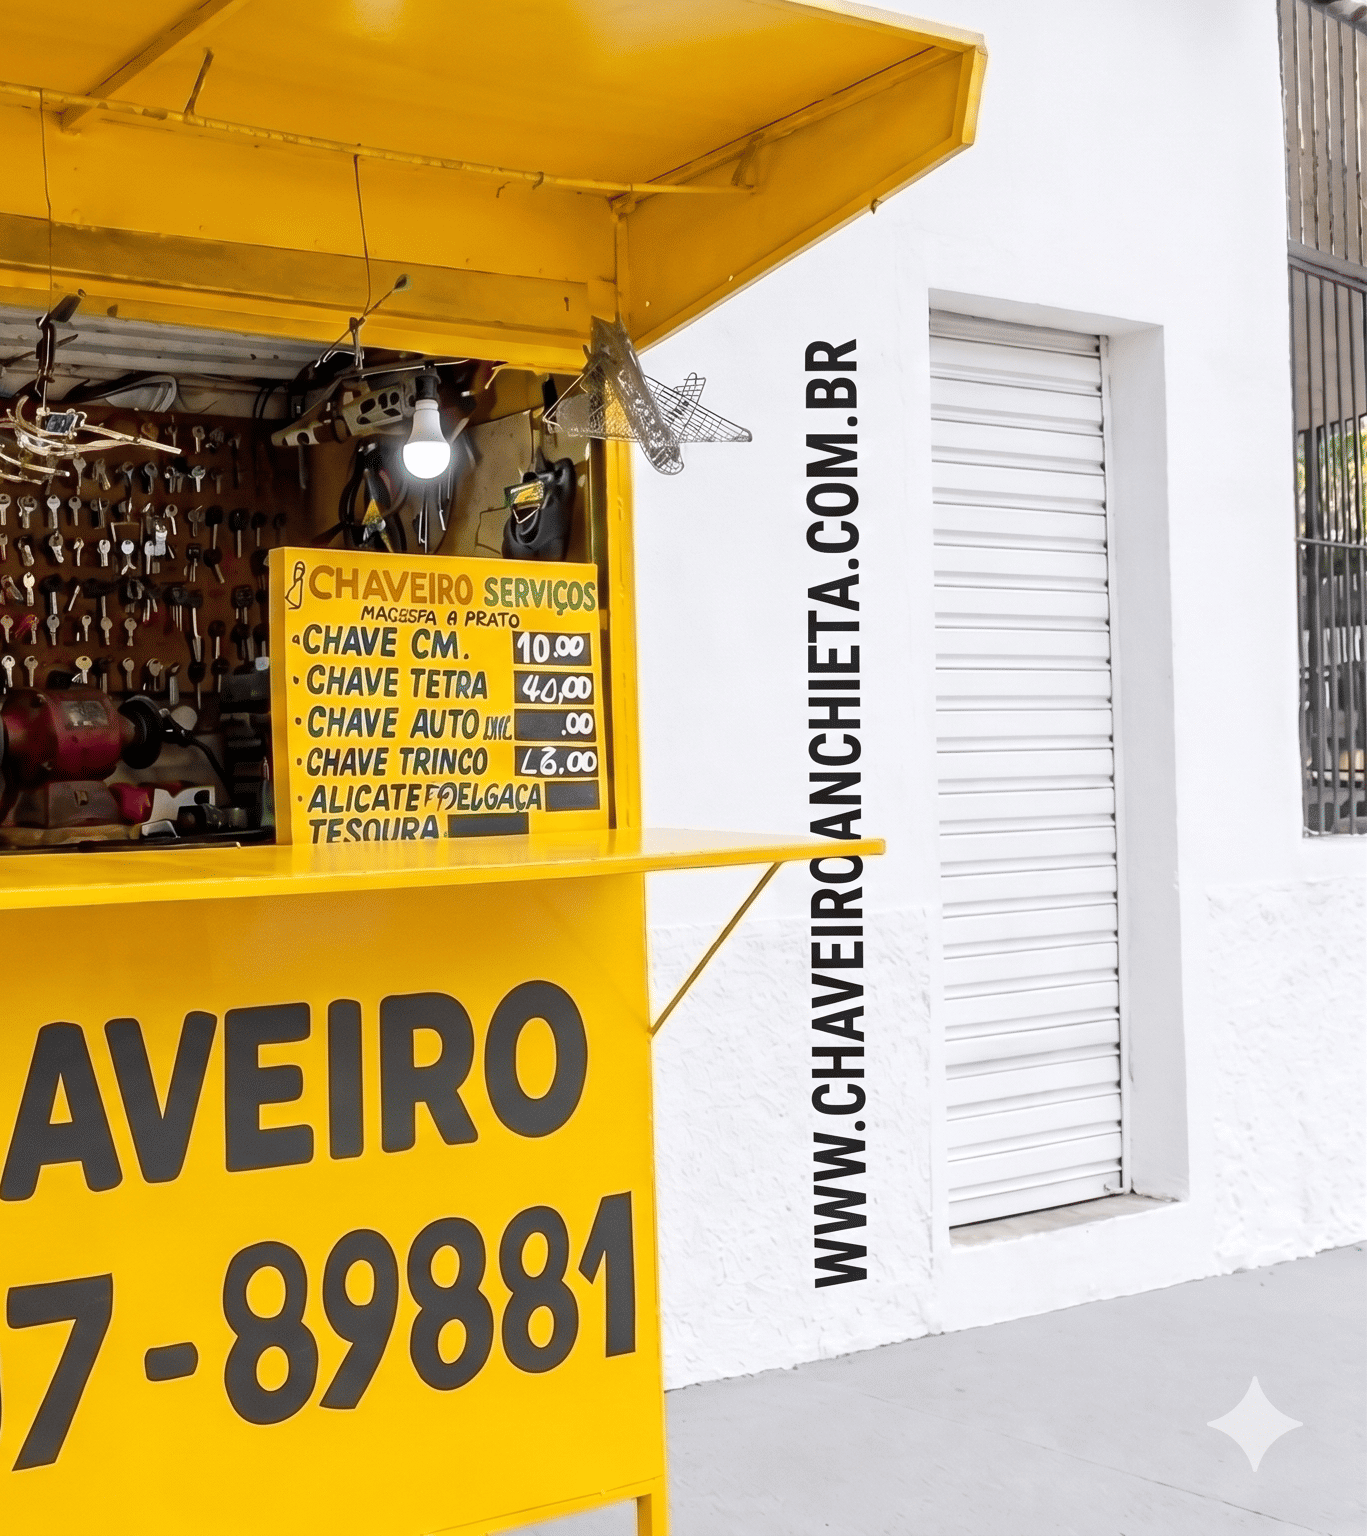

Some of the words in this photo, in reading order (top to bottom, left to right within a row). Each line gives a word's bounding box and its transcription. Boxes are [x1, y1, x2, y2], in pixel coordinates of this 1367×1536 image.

[308, 564, 474, 605] CHAVEIRO
[484, 577, 596, 615] SERVIÇOS
[447, 611, 457, 626] A
[465, 611, 520, 628] PRATO
[303, 624, 397, 657] CHAVE
[517, 632, 584, 663] 10.00
[307, 665, 398, 697] CHAVE
[411, 668, 487, 699] TETRA
[308, 706, 398, 738] CHAVE
[410, 709, 479, 739] AUTO
[307, 748, 389, 776] CHAVE
[400, 747, 487, 775] TRINCO
[309, 815, 440, 844] TESOURA
[805, 338, 868, 1288] WWW.CHAVEIROANCHIETA.COM.BR
